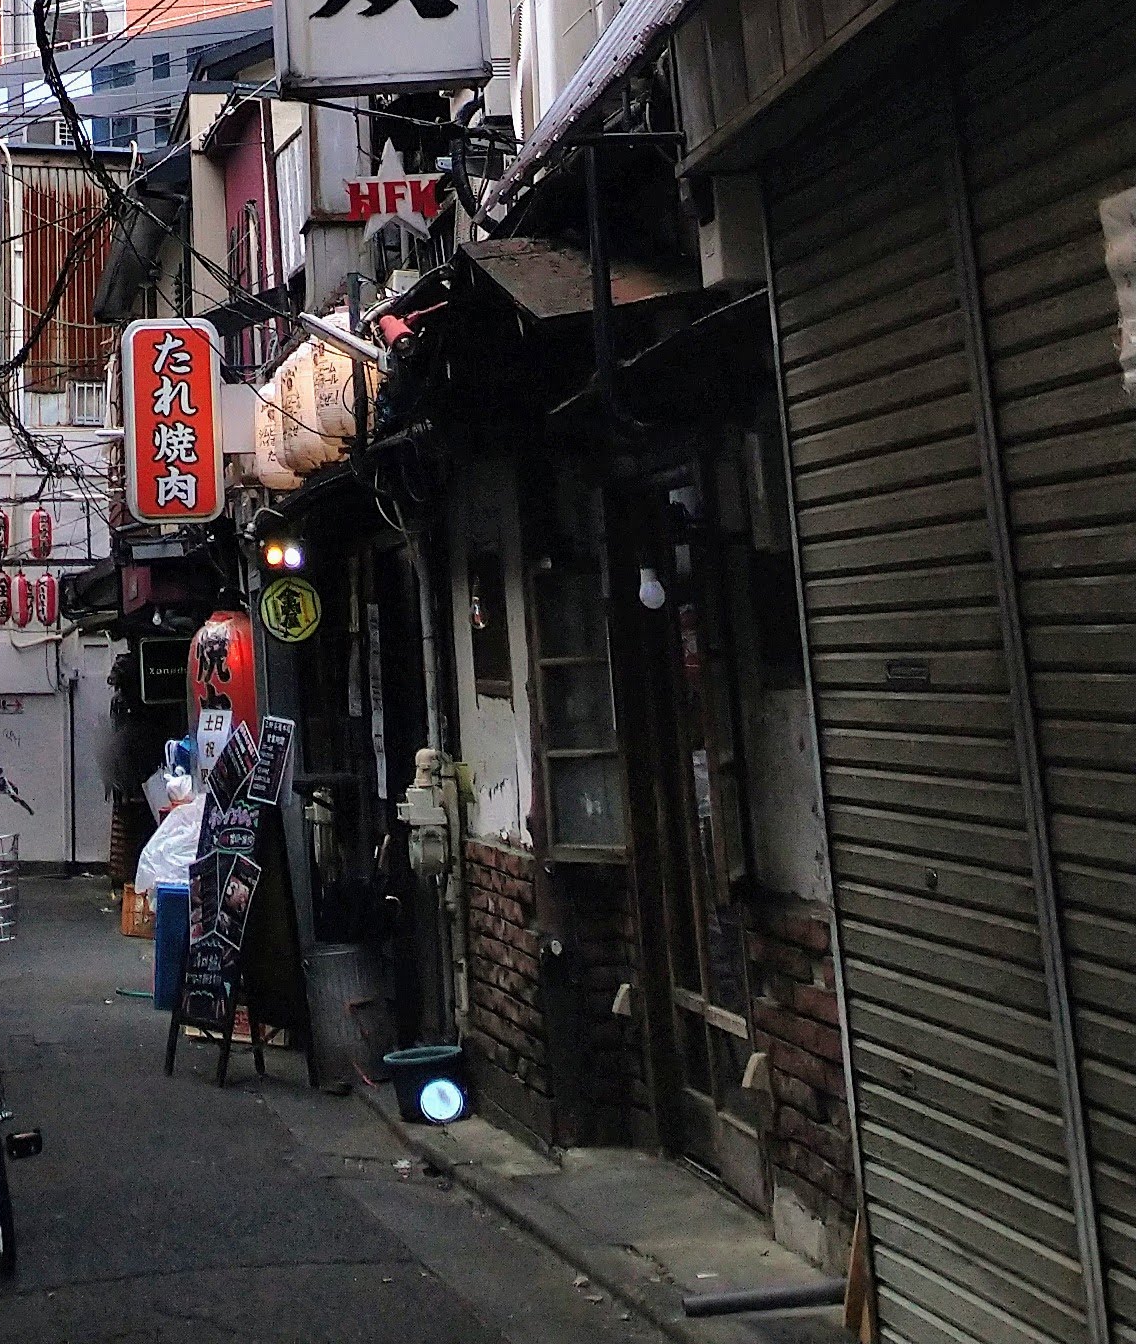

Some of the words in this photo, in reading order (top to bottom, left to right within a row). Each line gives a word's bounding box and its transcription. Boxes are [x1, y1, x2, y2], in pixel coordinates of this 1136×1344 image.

[151, 332, 198, 510] たれ焼肉
[203, 714, 225, 732] 土日
